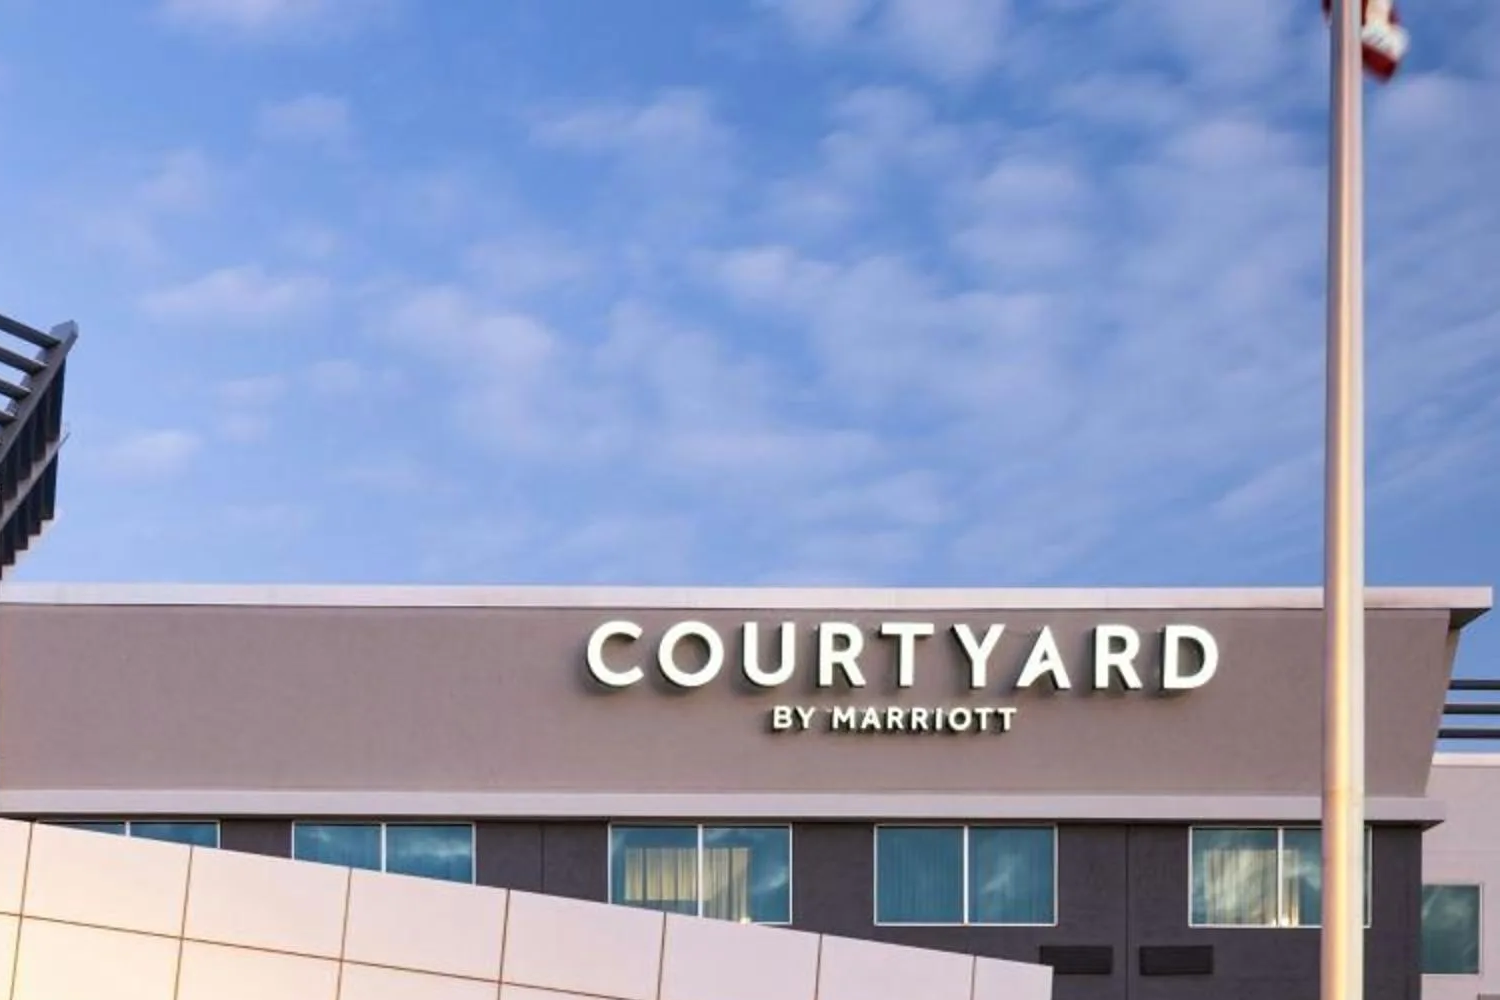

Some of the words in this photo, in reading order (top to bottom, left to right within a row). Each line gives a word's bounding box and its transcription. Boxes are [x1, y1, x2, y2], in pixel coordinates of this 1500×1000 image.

[586, 620, 1220, 690] COURTYARD
[772, 705, 815, 730] BY
[831, 705, 1017, 732] MARRIOTT
